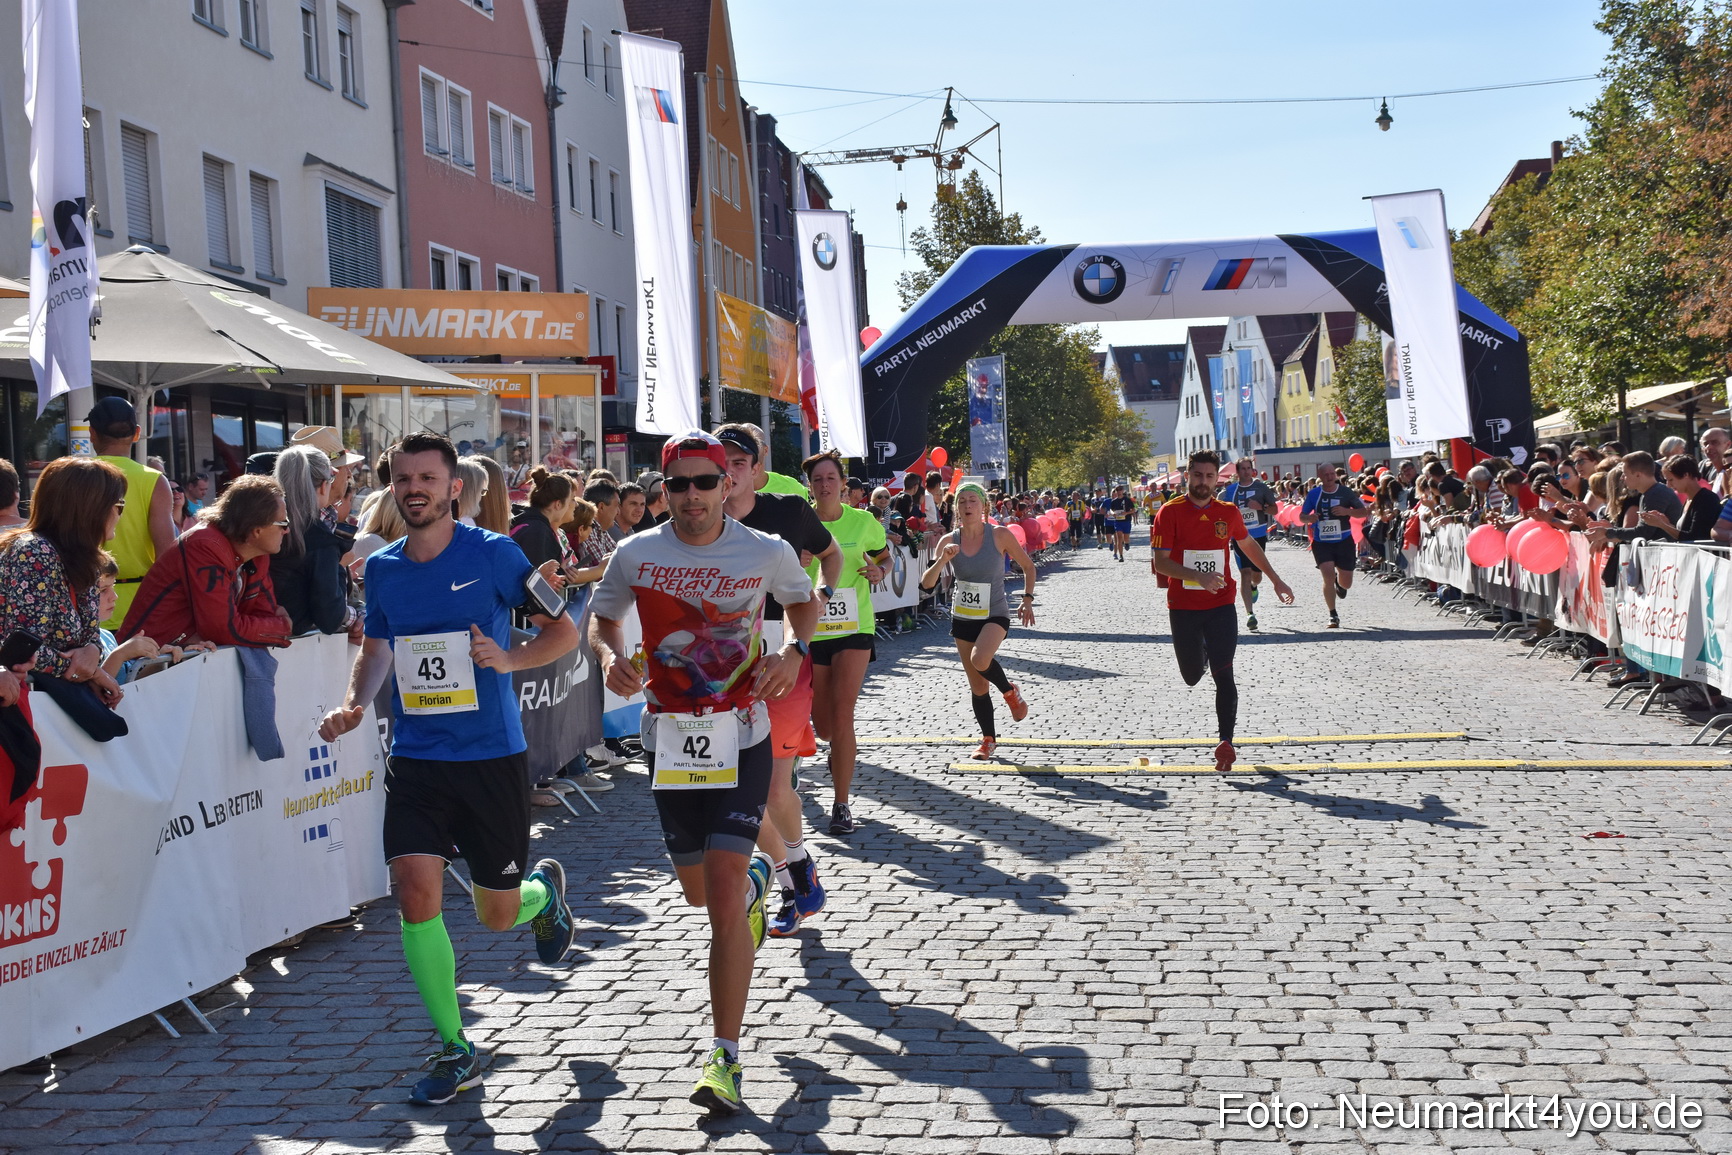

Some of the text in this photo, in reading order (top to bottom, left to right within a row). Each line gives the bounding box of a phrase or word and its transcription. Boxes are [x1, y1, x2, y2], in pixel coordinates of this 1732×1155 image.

[874, 298, 988, 378] PARTL NEUMARKT
[1322, 525, 1338, 533] 2281
[638, 562, 721, 580] FINISHER
[1194, 561, 1216, 573] 338
[651, 575, 763, 595] RELAY TEAM
[674, 589, 704, 598] ROTH
[961, 591, 980, 604] 334
[412, 641, 447, 651] BOCK
[418, 657, 446, 681] 43
[419, 694, 452, 706] Florian
[677, 720, 713, 729] BOCK
[683, 735, 711, 759] 42
[688, 773, 707, 782] Tim
[35, 940, 90, 974] EINZELNE
[91, 928, 128, 956] ZÄHLT
